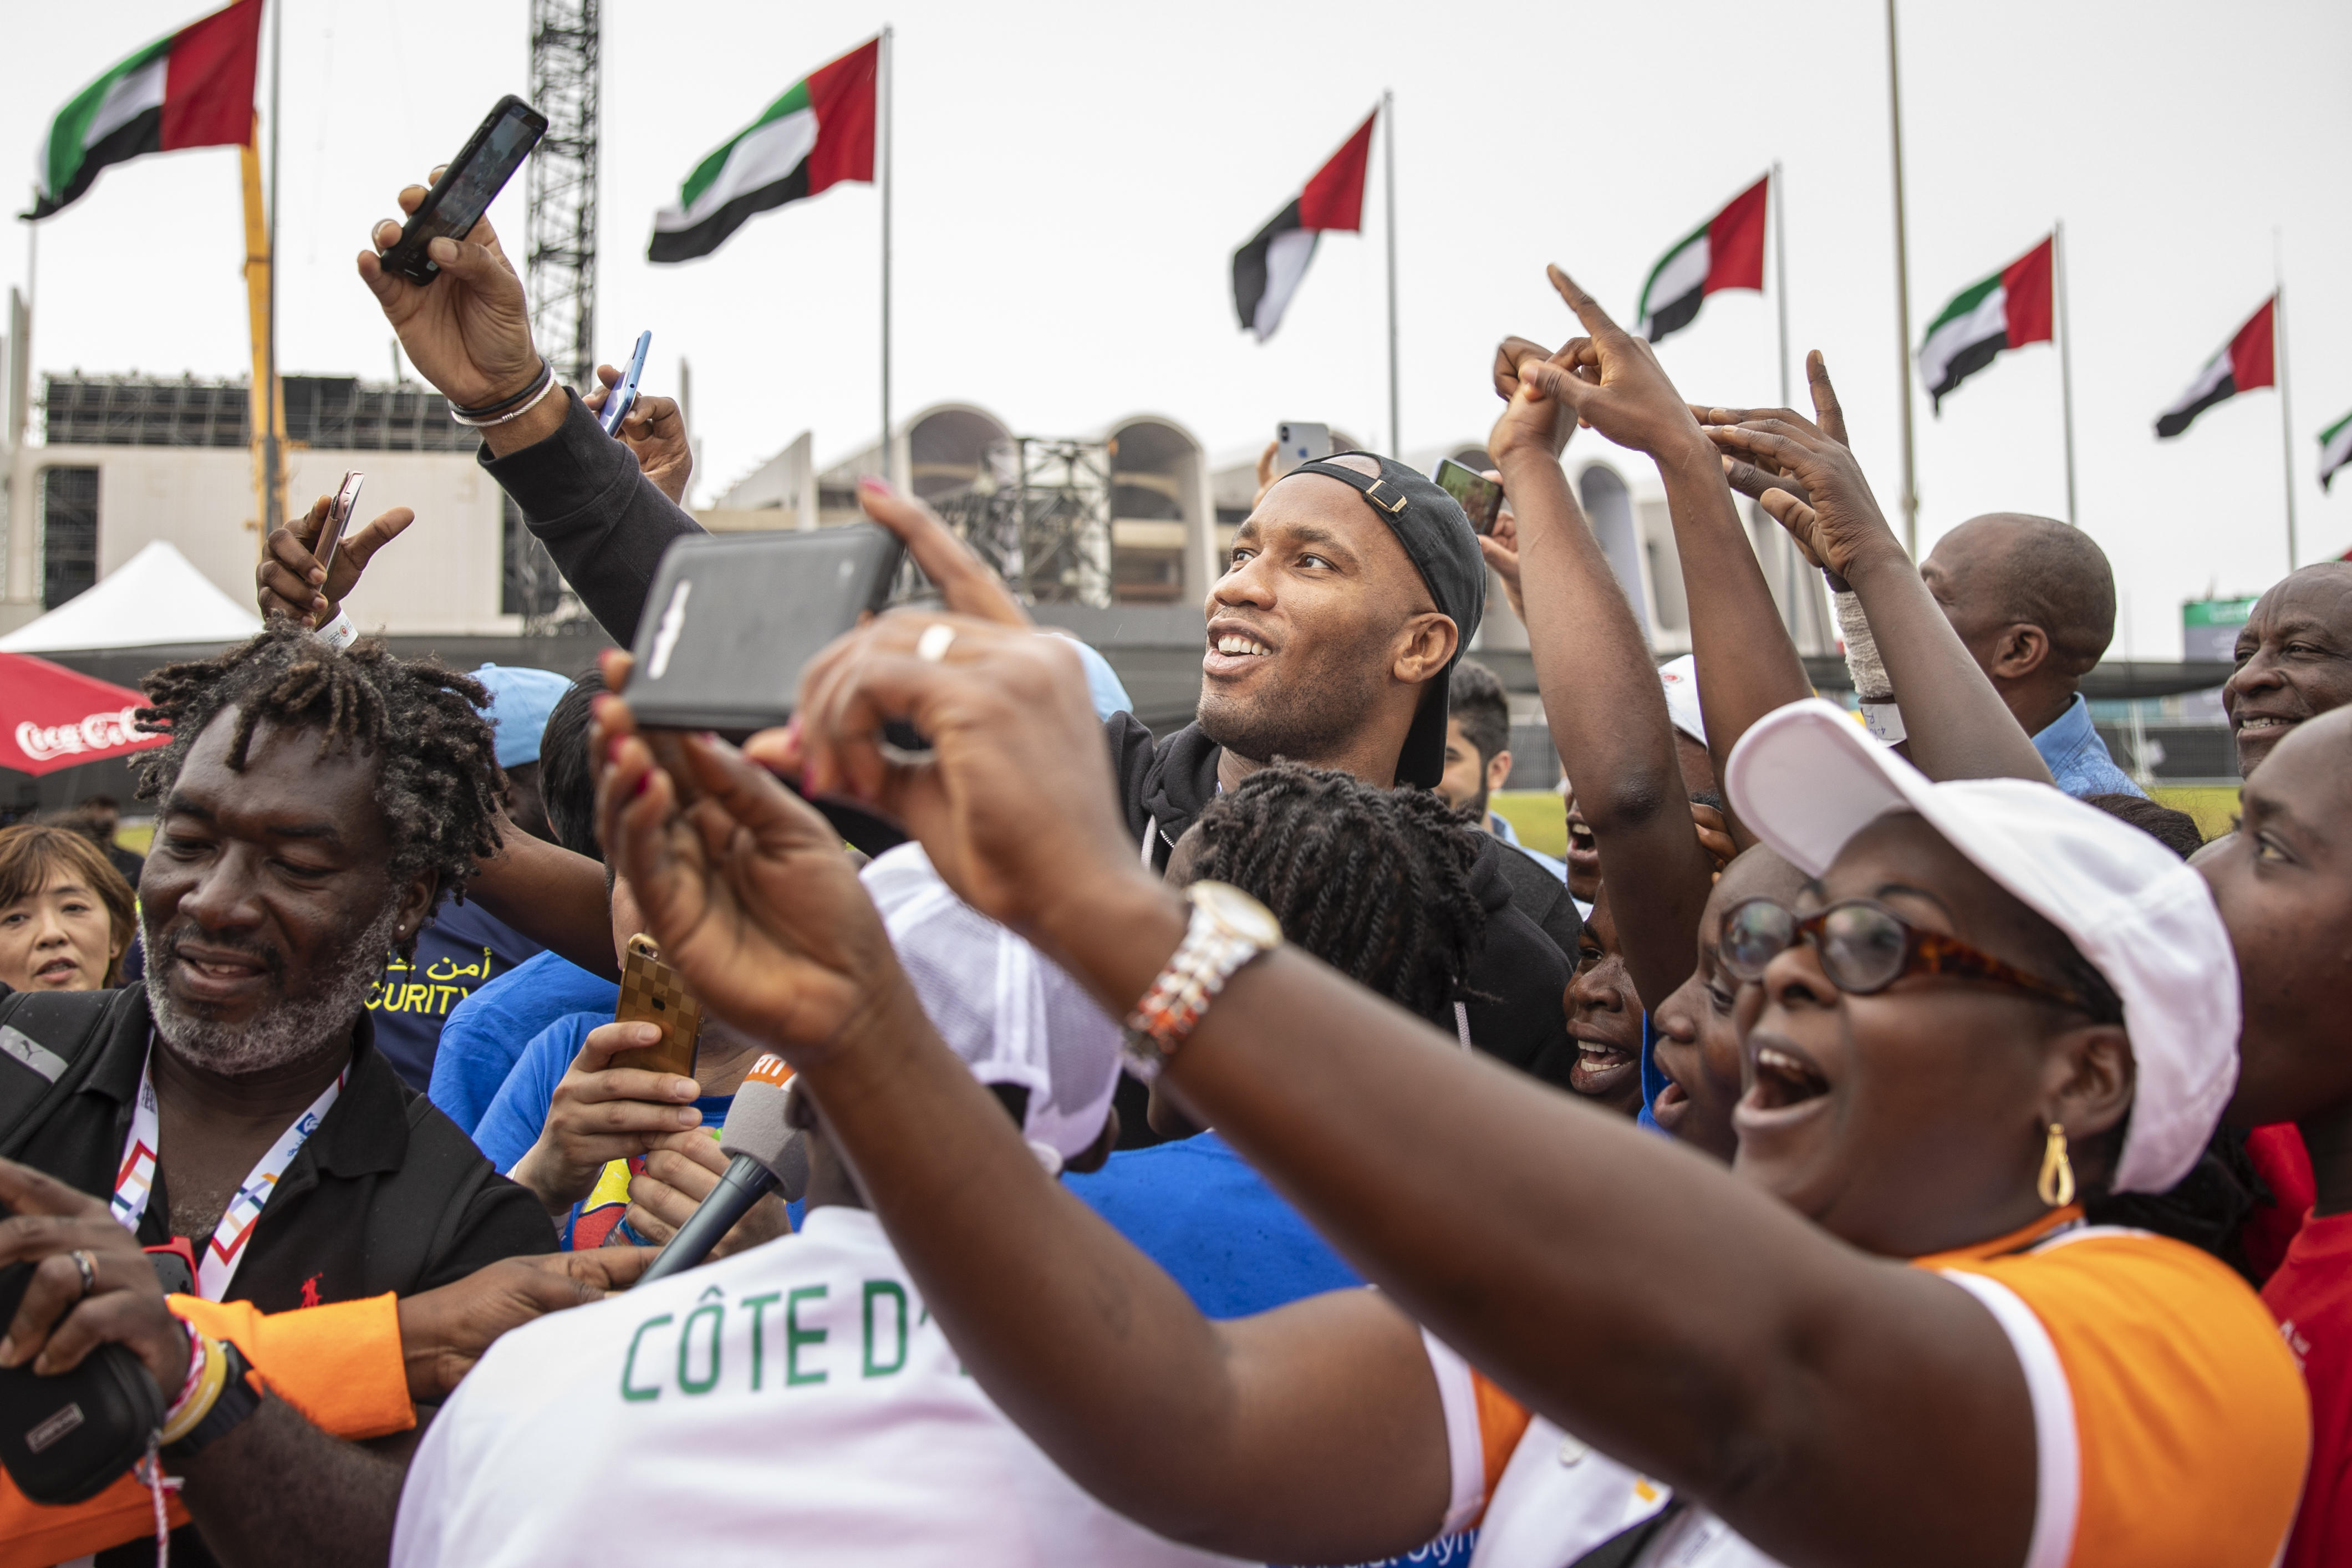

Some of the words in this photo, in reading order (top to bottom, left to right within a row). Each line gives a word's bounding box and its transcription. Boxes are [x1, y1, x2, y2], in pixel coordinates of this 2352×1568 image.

[426, 946, 492, 980] أمن
[622, 1284, 828, 1403] CÔTE
[862, 1279, 930, 1379] D'
